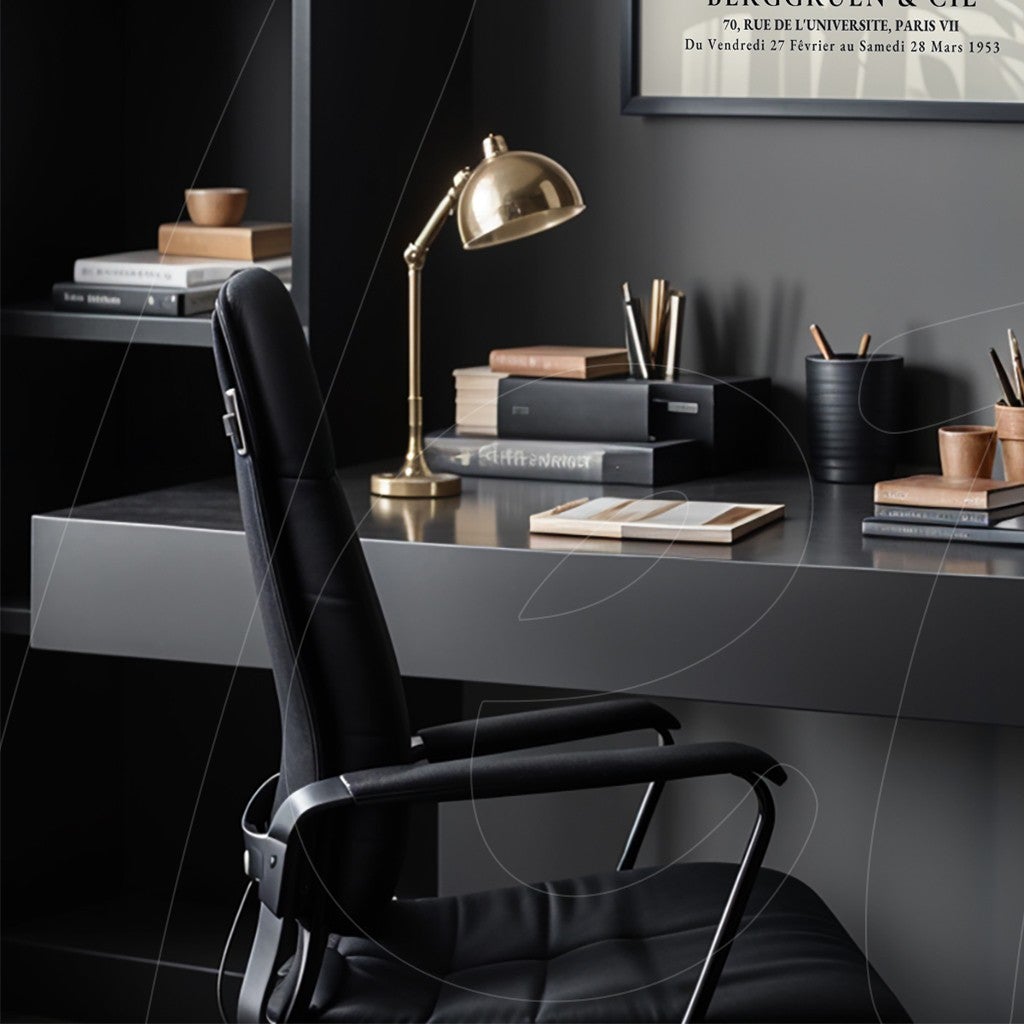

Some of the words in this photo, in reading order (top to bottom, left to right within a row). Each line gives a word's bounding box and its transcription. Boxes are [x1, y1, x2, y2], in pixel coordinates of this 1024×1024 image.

[722, 18, 742, 34] 70,
[742, 18, 772, 32] RUE
[773, 18, 793, 32] DE
[794, 18, 893, 35] L'UNIVERSITE,
[894, 19, 937, 33] PARIS
[939, 19, 960, 33] VII
[684, 38, 704, 52] Du
[707, 37, 766, 52] Vendredi
[769, 38, 786, 52] 27
[839, 42, 855, 53] au
[858, 38, 906, 54] Samedi
[909, 39, 927, 54] 28
[930, 39, 964, 54] Mars
[968, 40, 1001, 55] 1953
